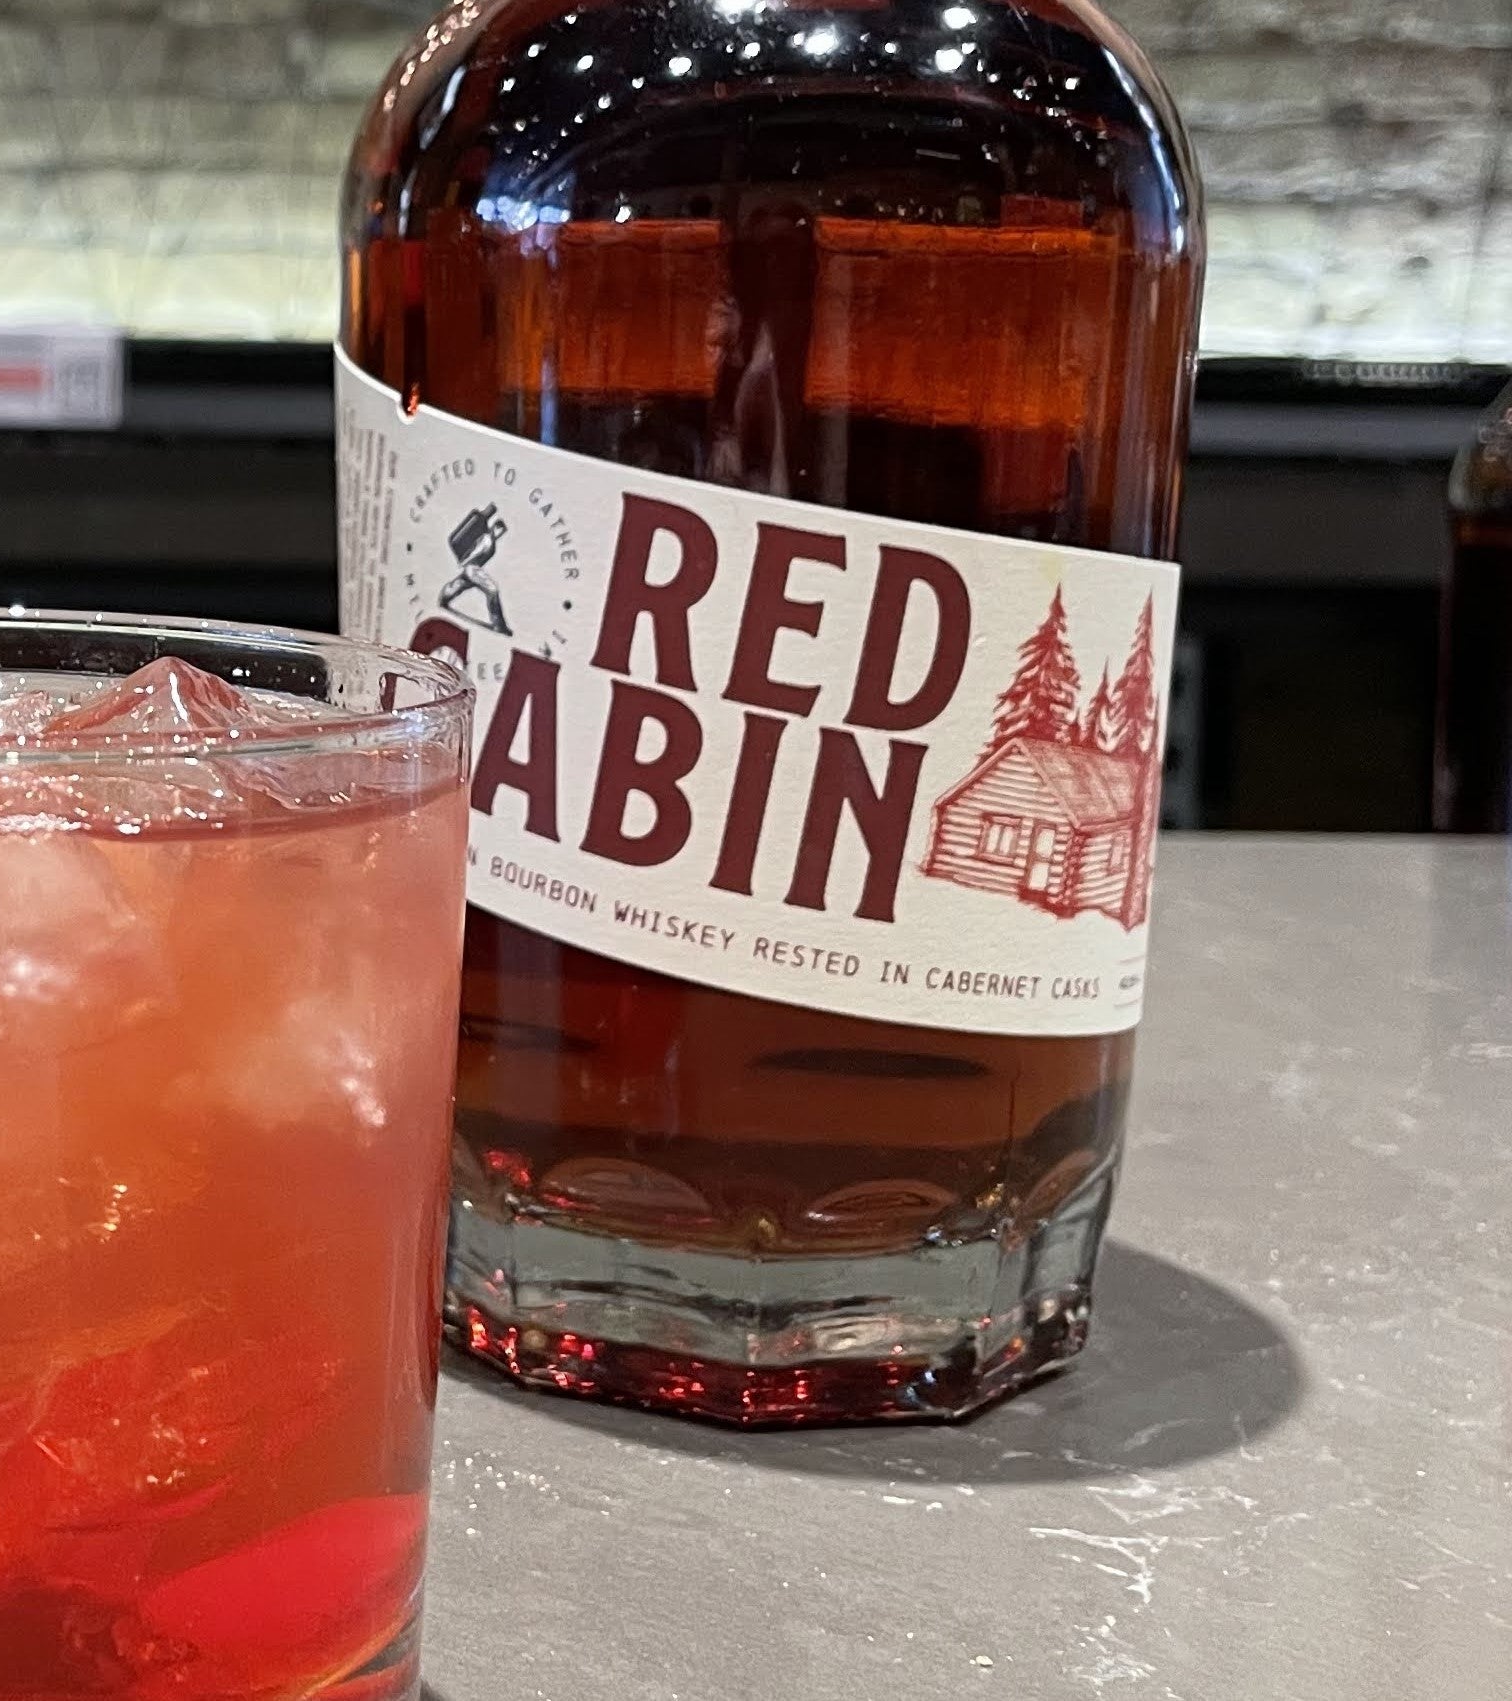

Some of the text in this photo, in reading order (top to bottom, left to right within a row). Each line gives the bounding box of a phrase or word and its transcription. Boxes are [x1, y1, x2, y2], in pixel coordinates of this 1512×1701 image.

[409, 458, 581, 580] CRAFTED TO GATHER
[591, 490, 973, 733] RED
[489, 855, 598, 914] BOURBON
[613, 899, 737, 951] WHISKEY
[752, 936, 861, 977] RESTED
[879, 960, 911, 985] IN
[925, 966, 1042, 999] CABERNET
[1050, 976, 1101, 1000] CASKS
